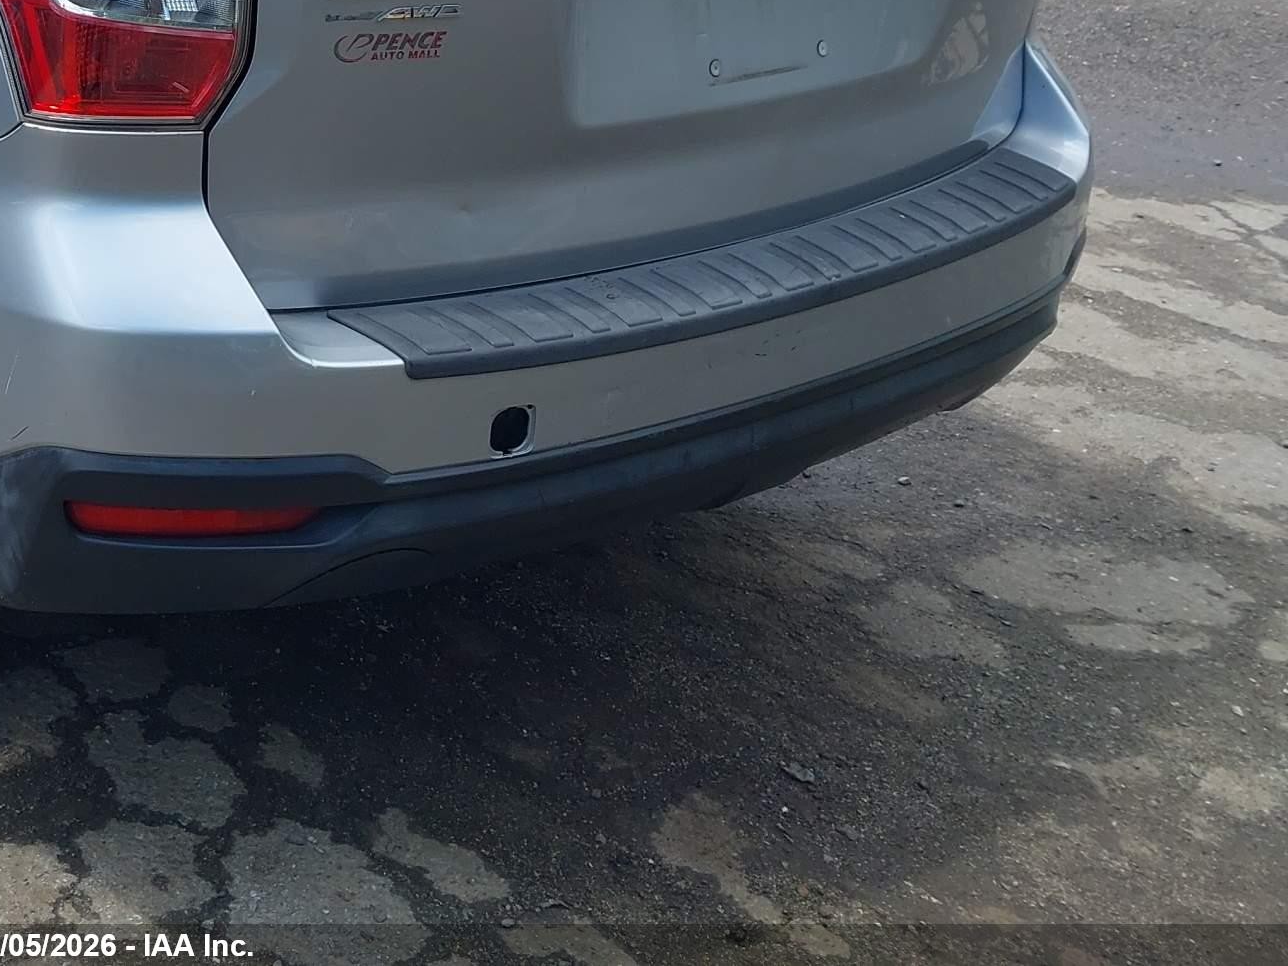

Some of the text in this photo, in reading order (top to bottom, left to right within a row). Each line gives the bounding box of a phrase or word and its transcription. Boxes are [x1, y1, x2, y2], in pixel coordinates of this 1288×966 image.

[371, 31, 448, 51] PENCE
[371, 49, 441, 61] AUTO MALL
